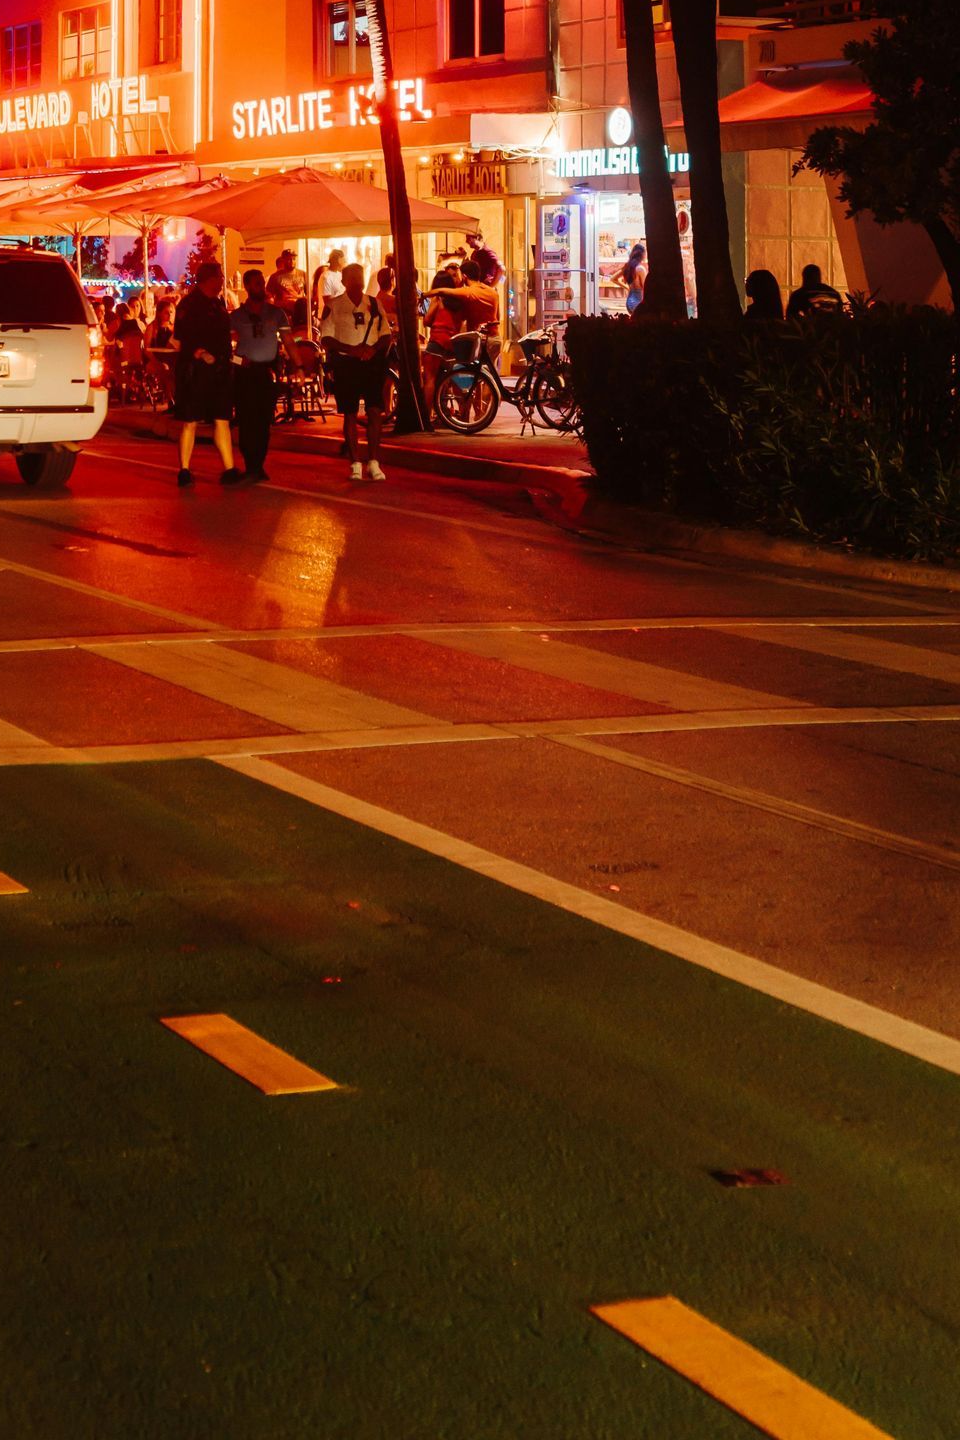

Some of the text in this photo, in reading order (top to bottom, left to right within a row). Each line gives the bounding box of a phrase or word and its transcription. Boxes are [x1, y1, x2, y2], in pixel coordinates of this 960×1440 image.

[91, 74, 158, 120] HOTEL
[232, 78, 432, 139] STARLITE HOEL
[431, 164, 510, 198] STARLITE HOTEL
